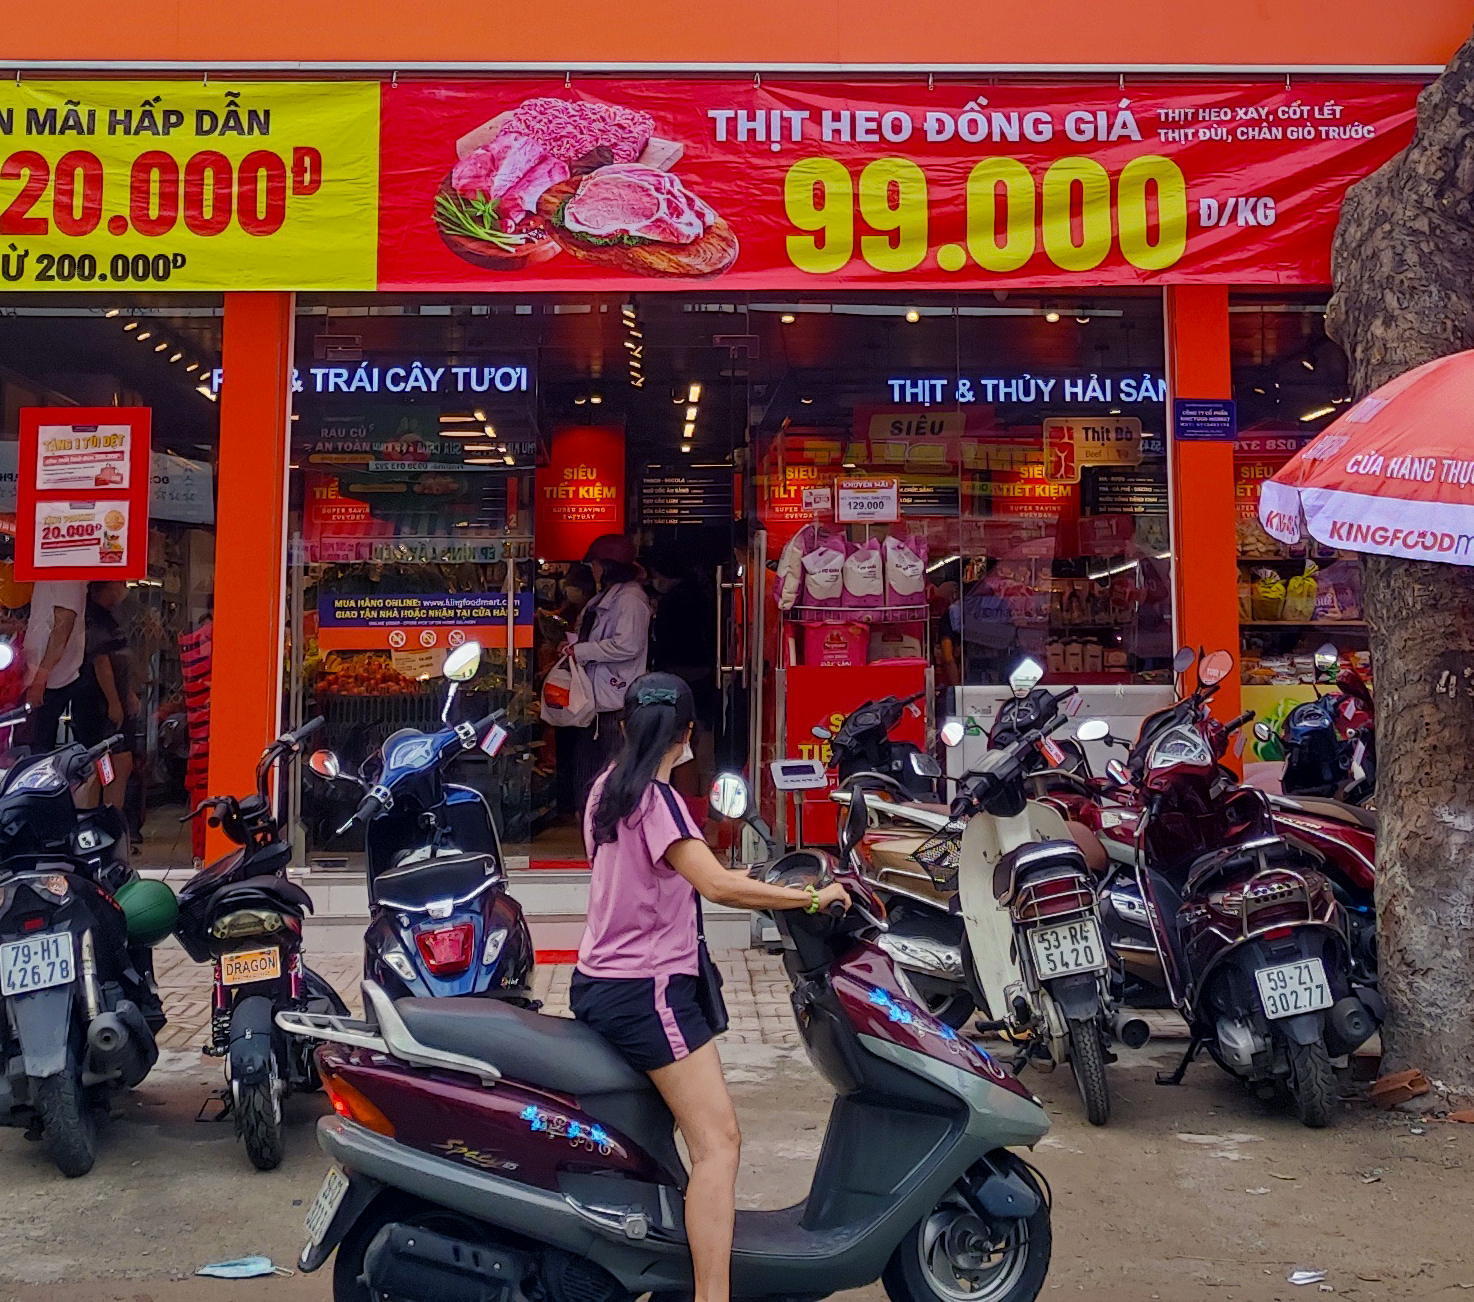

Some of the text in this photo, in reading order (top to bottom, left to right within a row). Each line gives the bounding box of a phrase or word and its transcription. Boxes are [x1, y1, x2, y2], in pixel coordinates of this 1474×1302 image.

[25, 100, 96, 136] MÃI
[108, 95, 185, 137] HẤP
[195, 92, 272, 137] DẪN
[707, 96, 1143, 153] THỊT HEO ĐỒNG GIÁ
[1157, 98, 1344, 125] THỊT HEO XAY, CỐT LẾT
[1157, 126, 1195, 145] THỊT
[1236, 122, 1283, 142] CHÂN
[1285, 121, 1316, 141] GIÒ
[1319, 119, 1376, 140] TRƯỚC
[785, 153, 1277, 274] 99.000 Đ/KG
[309, 361, 528, 393] TRÁI CÂY TƯƠI
[888, 378, 948, 406] THỊT
[956, 379, 975, 403] &
[981, 373, 1057, 403] THỦY
[1065, 373, 1112, 403] HẢI
[890, 415, 944, 436] SIÊU
[1082, 426, 1111, 447] Thịt
[43, 437, 72, 455] TẶNG
[83, 436, 102, 450] TÚI
[103, 433, 125, 450] DỆT
[563, 464, 597, 480] SIÊU
[1240, 463, 1274, 478] SIÊU
[1346, 450, 1385, 475] CỬA
[1386, 456, 1437, 483] HÀNG
[543, 482, 616, 502] TIẾT KIỆM
[1001, 479, 1072, 500] TIẾT KIỆM
[847, 501, 884, 510] 129.000
[334, 599, 356, 608] MUA
[357, 597, 383, 608] HÀNG
[335, 610, 358, 618] GIAO
[379, 608, 400, 618] NHÀ
[1038, 924, 1091, 951] 53-R4
[9, 939, 61, 967] 79-H1
[226, 954, 276, 976] DRAGON
[1046, 946, 1095, 973] 5420
[6, 960, 71, 990] 426.78
[1266, 964, 1314, 991] 59-Z1
[1266, 984, 1325, 1016] 302.77
